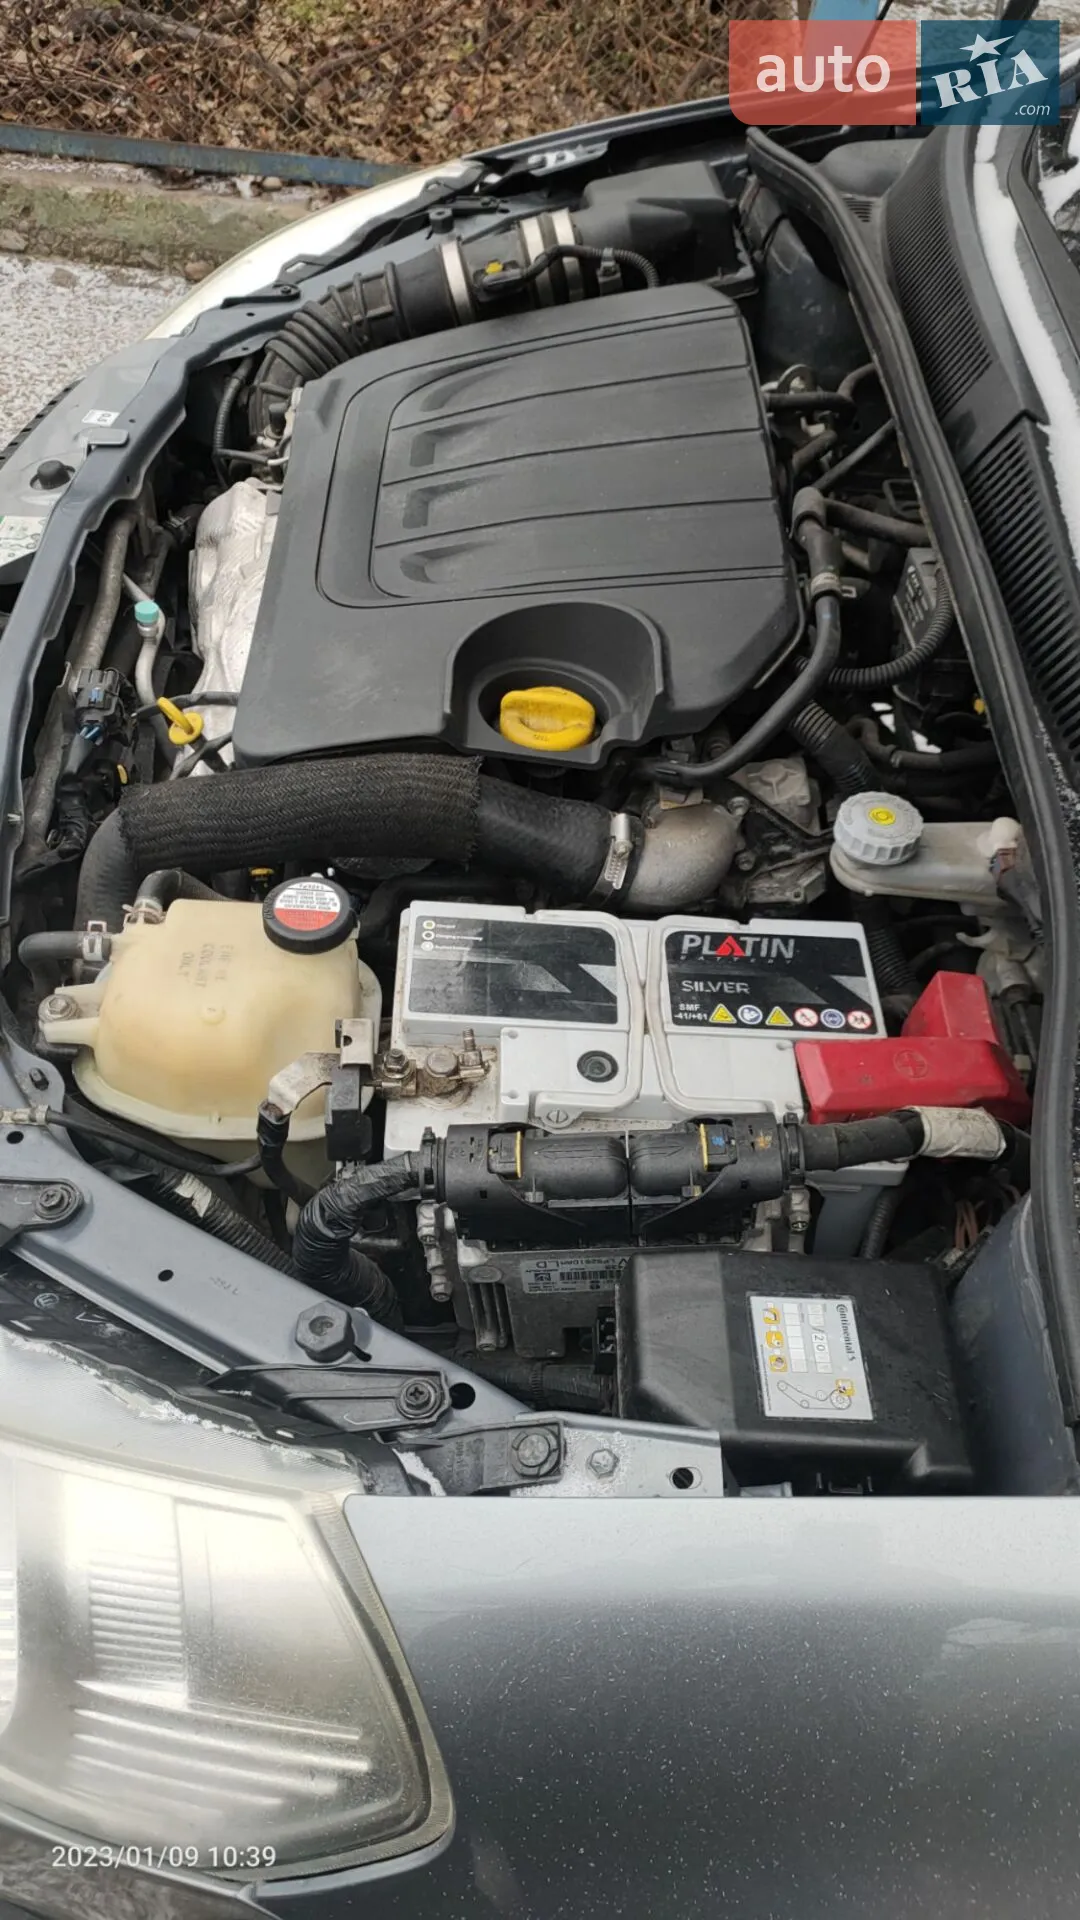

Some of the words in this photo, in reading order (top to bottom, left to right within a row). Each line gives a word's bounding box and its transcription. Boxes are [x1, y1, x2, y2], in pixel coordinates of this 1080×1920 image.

[680, 934, 796, 959] PLATIN
[681, 980, 751, 994] SILVER
[678, 1003, 701, 1012] SMF
[836, 1303, 855, 1354] Continental
